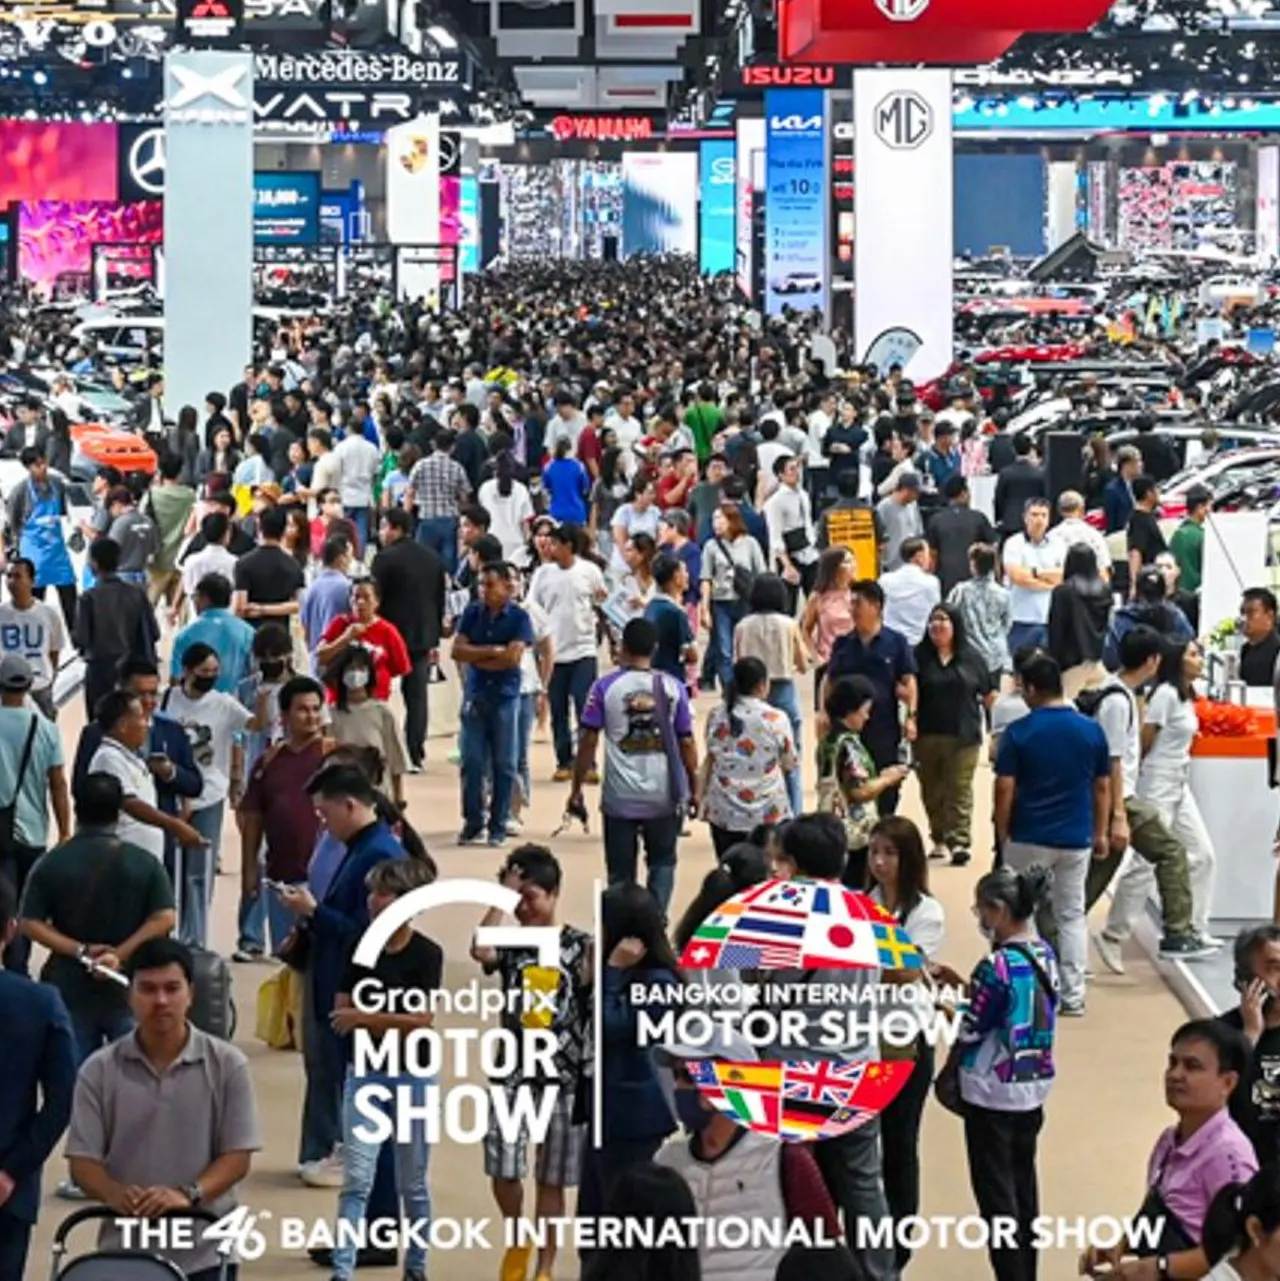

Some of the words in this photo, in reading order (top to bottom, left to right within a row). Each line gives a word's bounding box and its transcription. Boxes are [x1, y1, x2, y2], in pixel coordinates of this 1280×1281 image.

[252, 52, 459, 82] Mercedes-Benz
[742, 66, 835, 85] ISUZU
[573, 116, 652, 138] YAMAHA
[879, 99, 925, 144] MG
